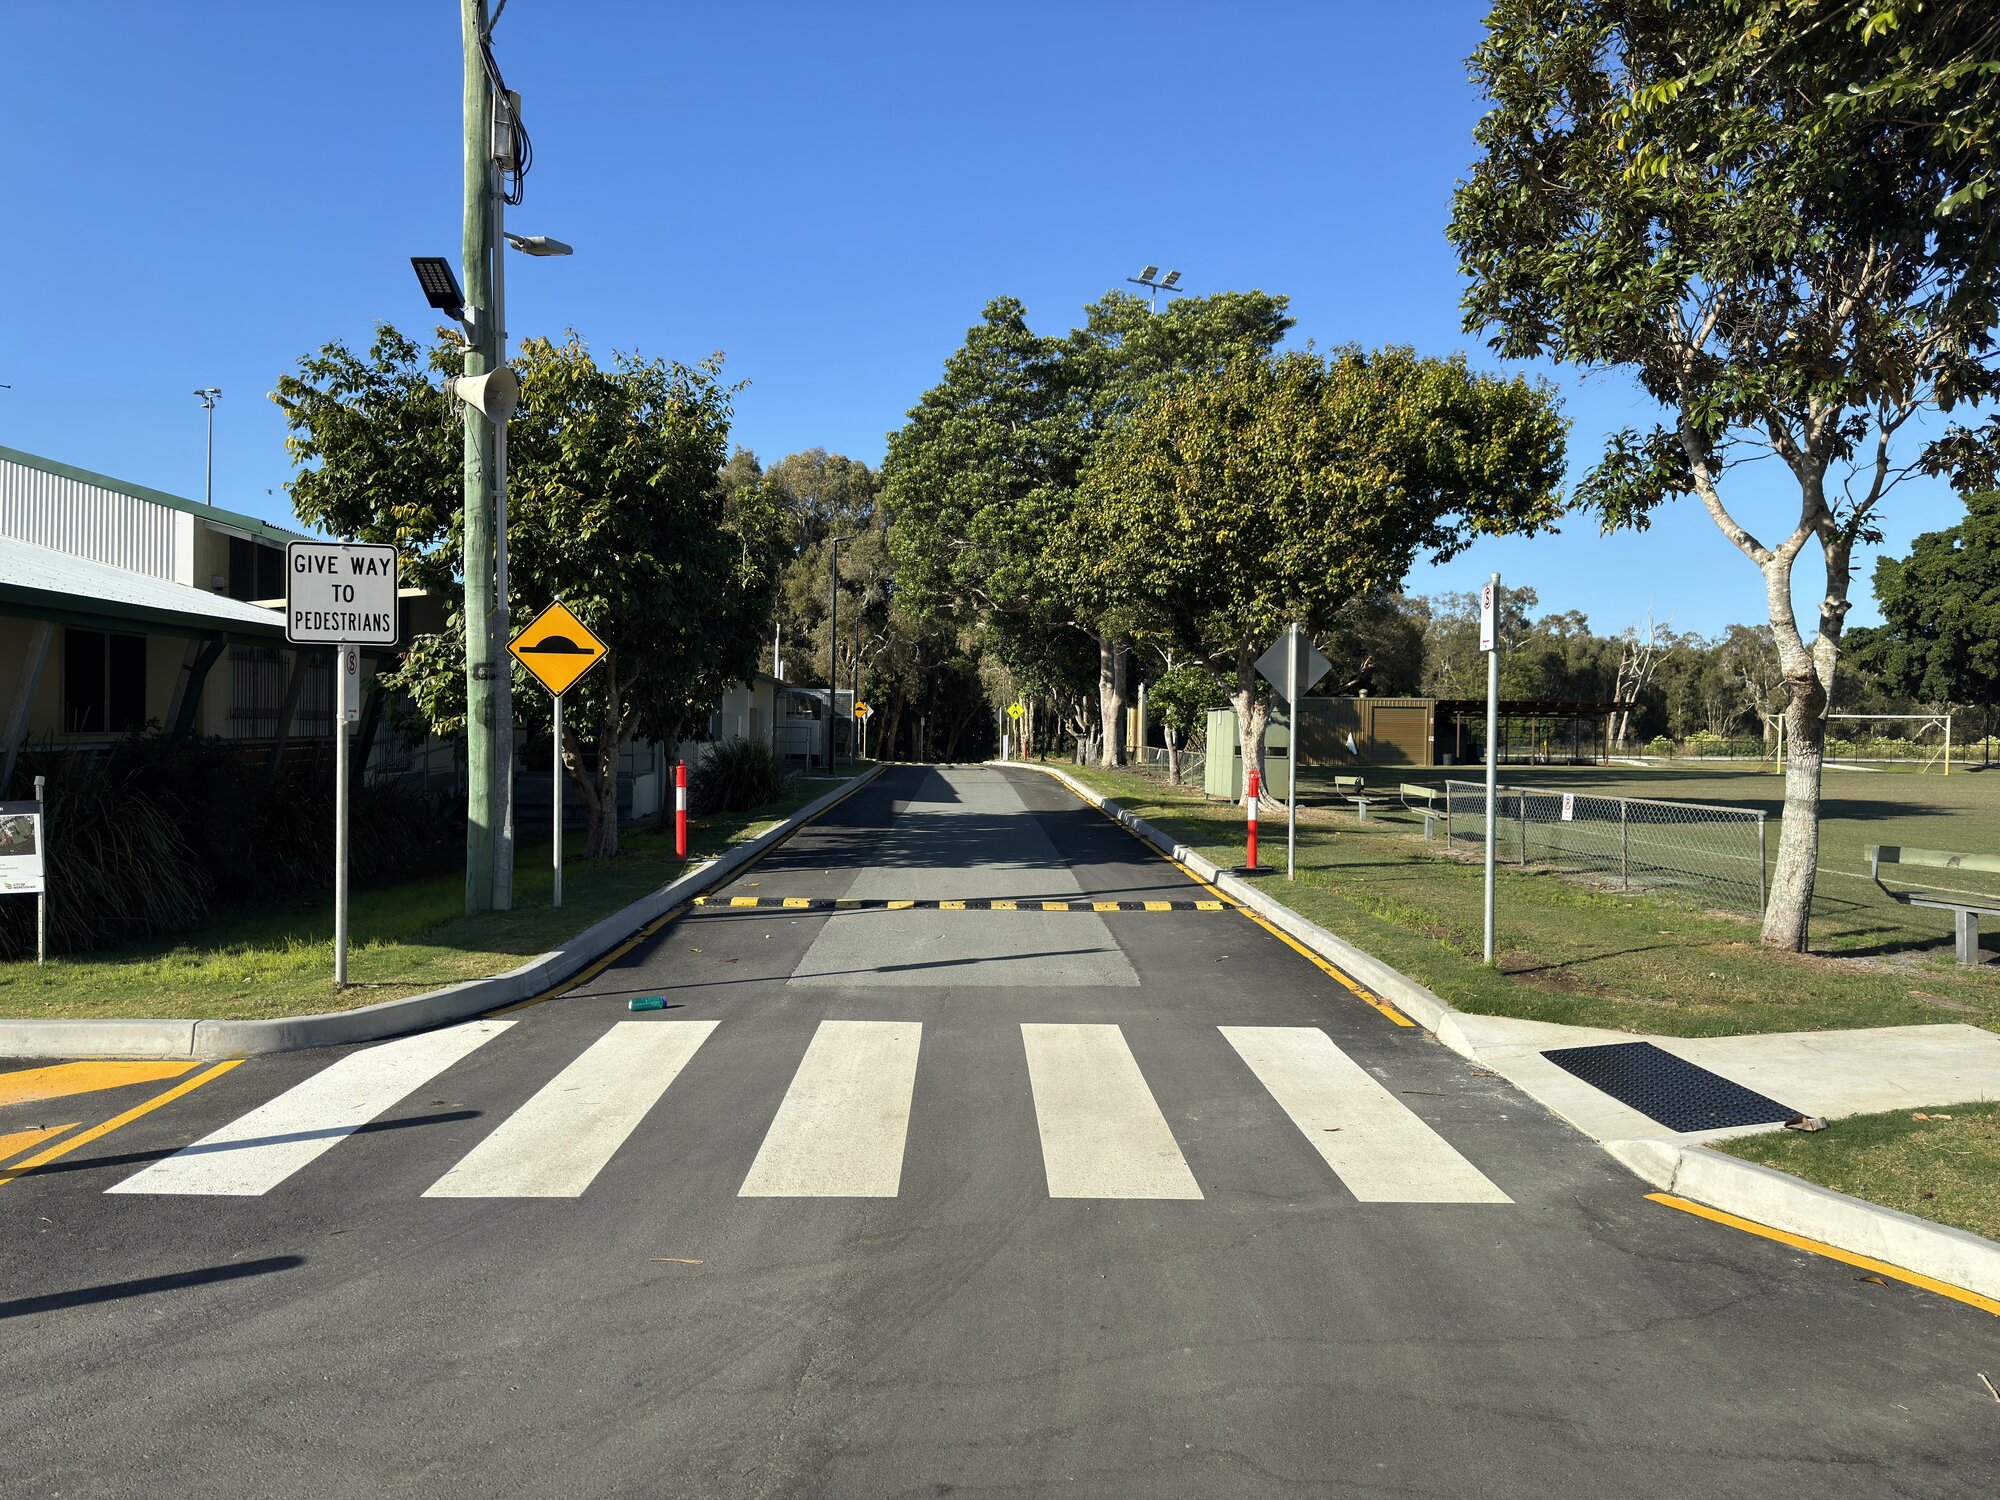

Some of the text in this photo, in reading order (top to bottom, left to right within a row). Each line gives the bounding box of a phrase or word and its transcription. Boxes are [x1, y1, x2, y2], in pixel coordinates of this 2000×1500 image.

[294, 554, 391, 576] GIVE WAY
[331, 584, 355, 603] TO
[295, 610, 390, 632] PEDESTRIANS
